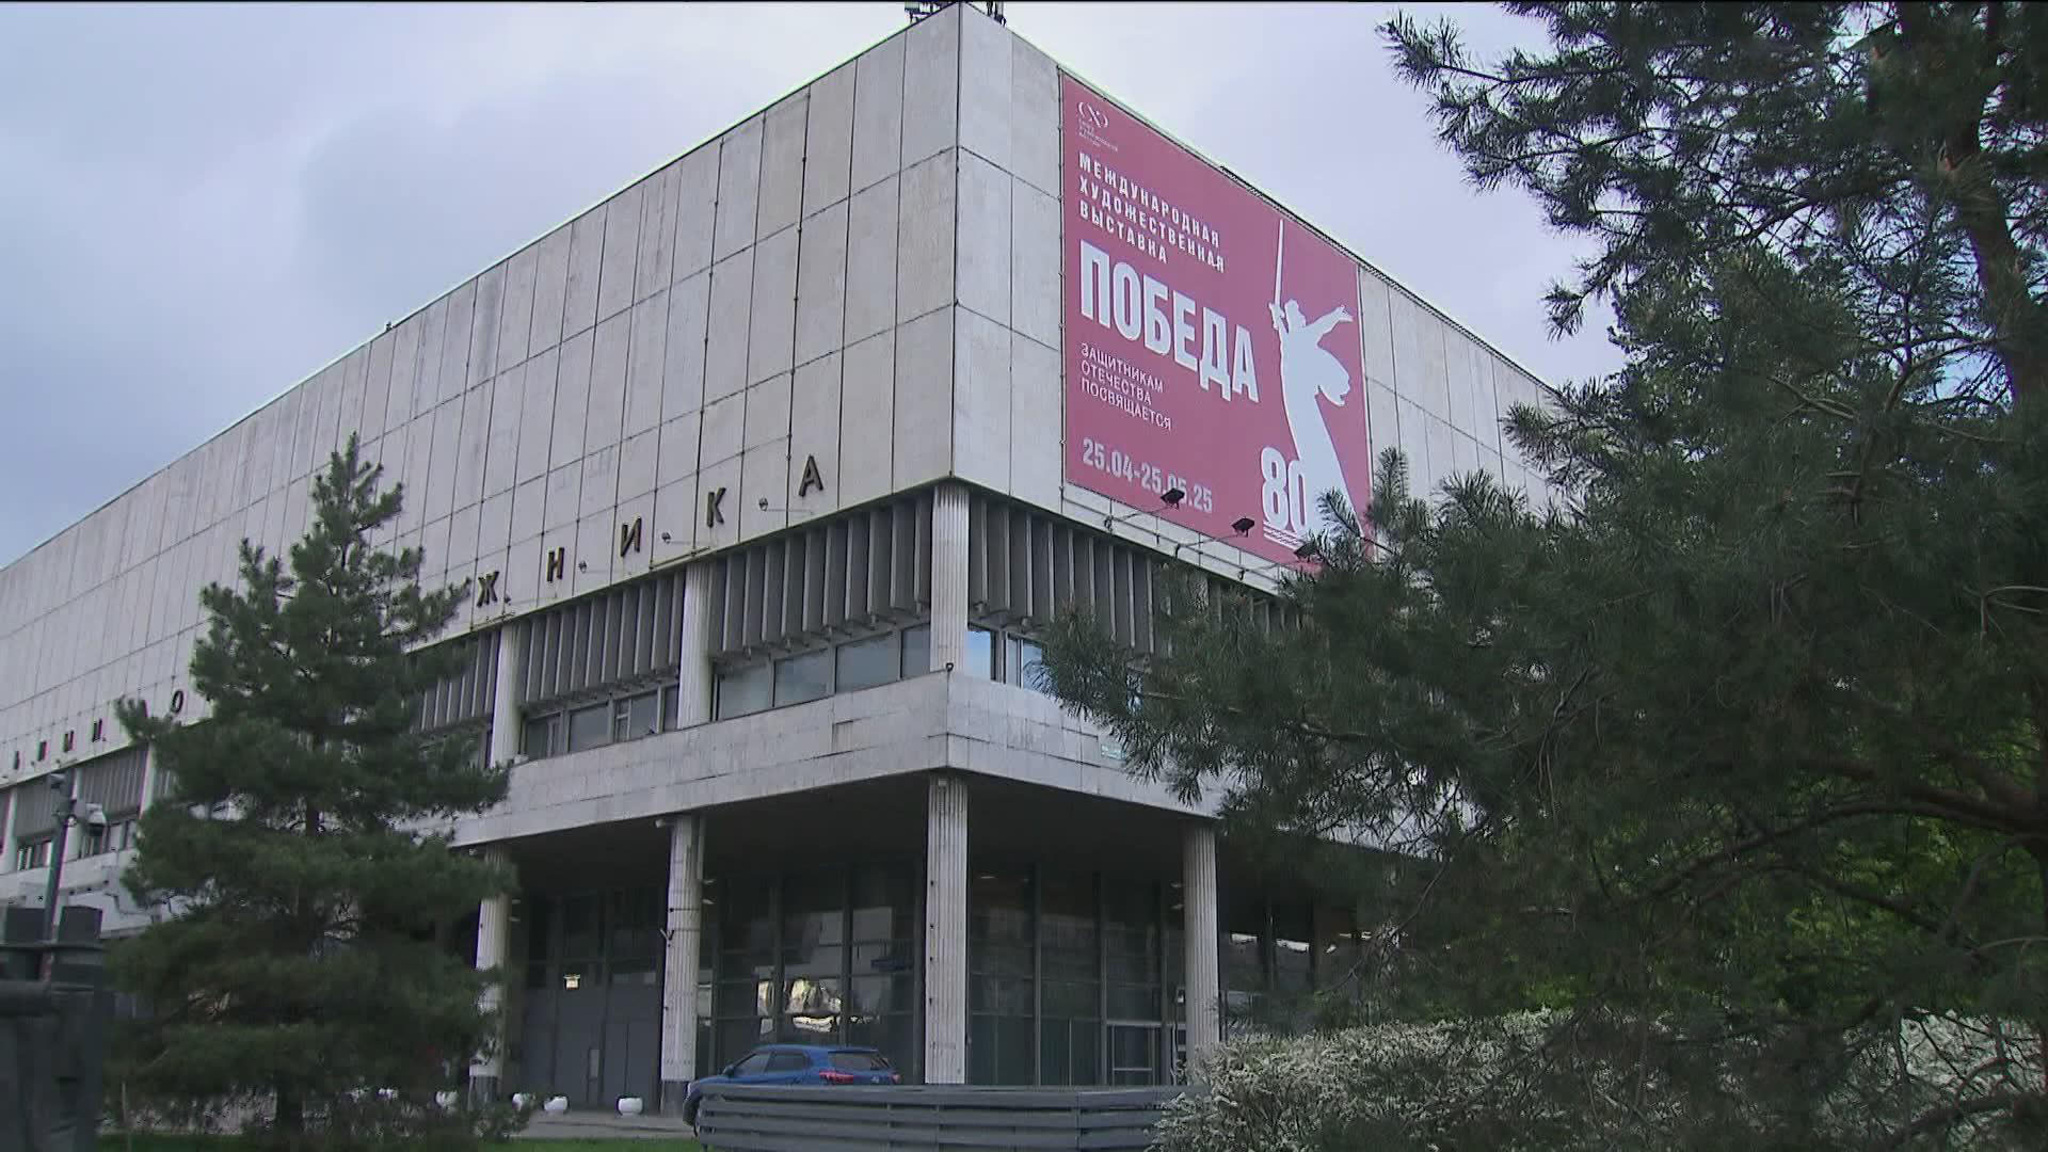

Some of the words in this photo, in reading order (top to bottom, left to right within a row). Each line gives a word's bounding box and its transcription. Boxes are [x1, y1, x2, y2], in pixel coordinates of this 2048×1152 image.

[1079, 152, 1220, 248] МЕЖДУНАРОДНАЯ
[1079, 176, 1225, 273] ХУДОЖЕСТВЕННАЯ
[1080, 200, 1168, 264] ВЫСТАВКА
[1080, 240, 1259, 403] ПОБЕДА
[1081, 342, 1163, 394] ЗАЩИТНИКАМ
[1081, 360, 1152, 405] ОТЕЧЕСТВА
[1081, 377, 1172, 431] ПОСВЯЩАЕТСЯ
[1261, 447, 1309, 537] 80
